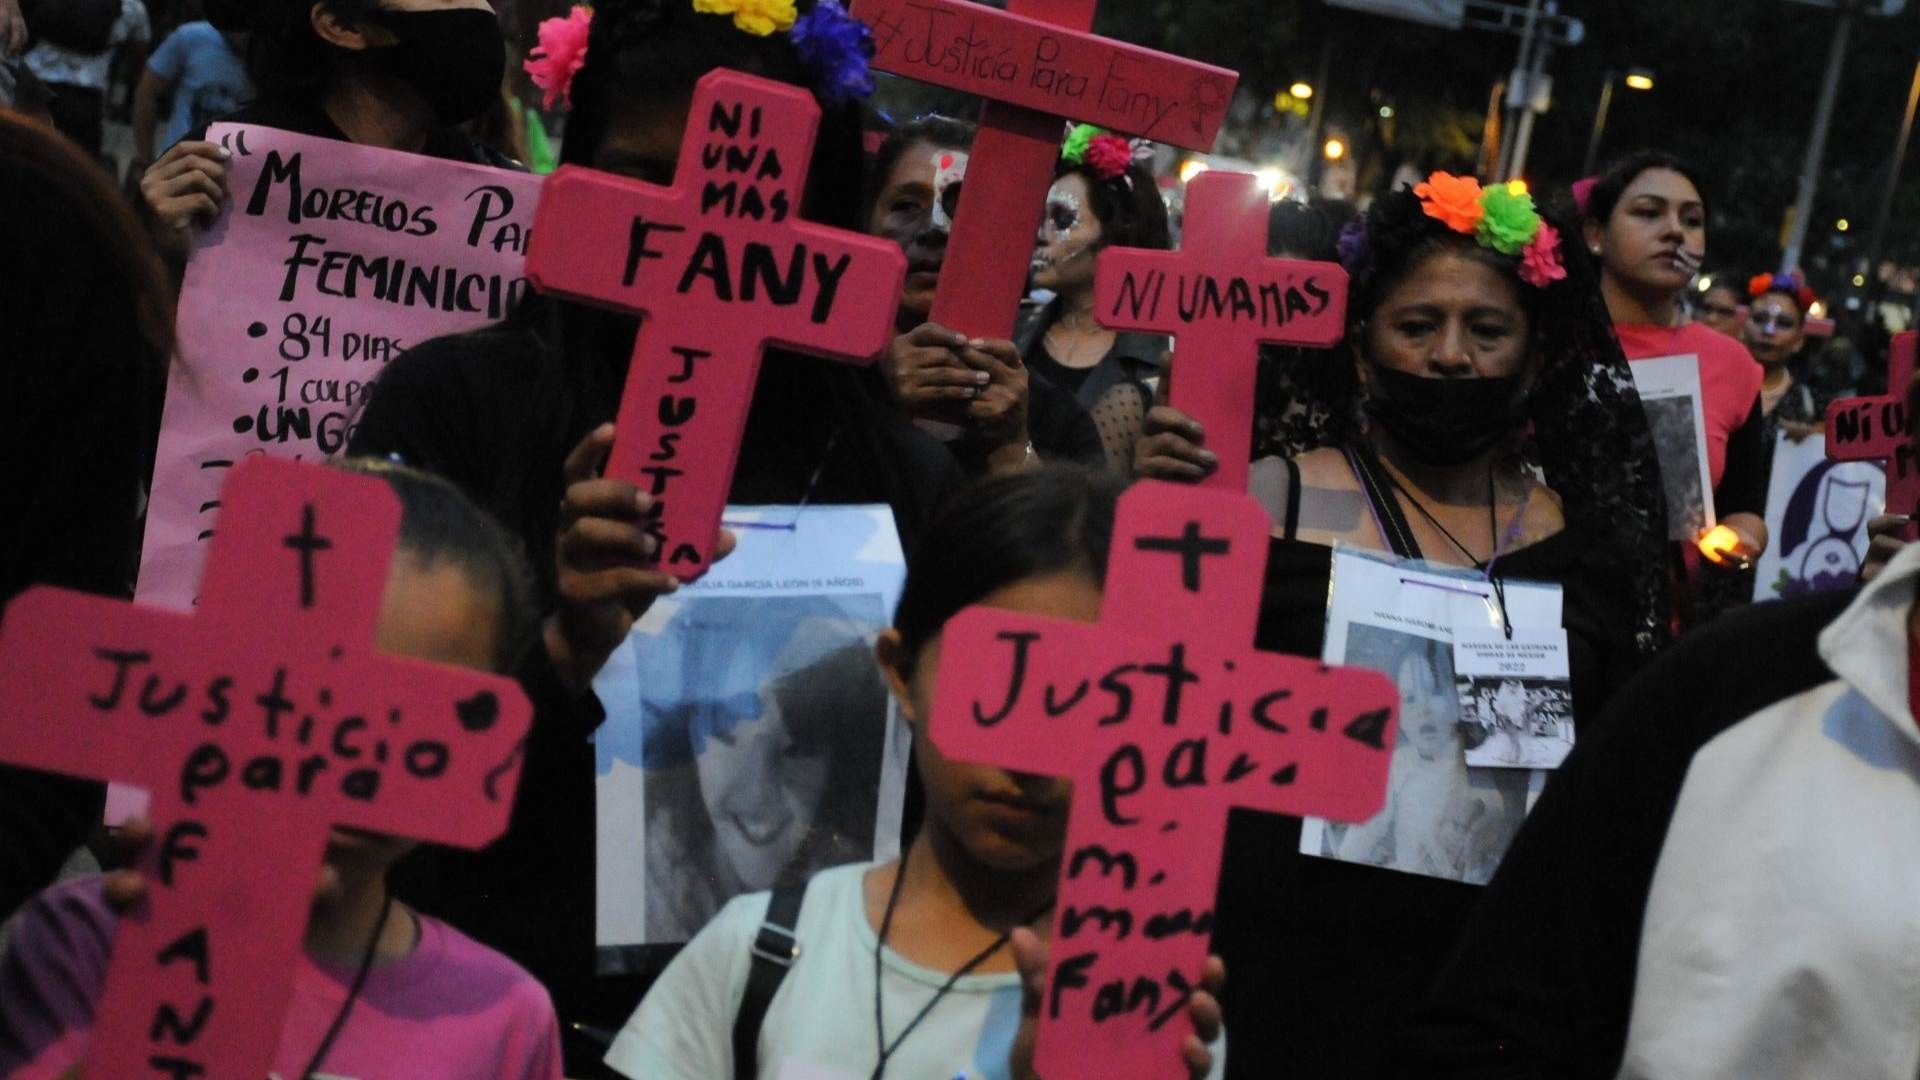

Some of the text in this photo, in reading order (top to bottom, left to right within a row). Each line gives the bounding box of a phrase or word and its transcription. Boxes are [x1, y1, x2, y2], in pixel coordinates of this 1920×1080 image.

[709, 101, 763, 137] NI
[702, 143, 782, 181] UNA
[464, 185, 533, 256] PA
[700, 181, 790, 223] MAS
[622, 215, 852, 324] FANY
[1111, 269, 1167, 322] NI
[278, 312, 331, 362] 84
[269, 366, 289, 403] 1
[256, 404, 311, 443] UN
[973, 632, 1392, 750] Justicia
[180, 745, 382, 802] para
